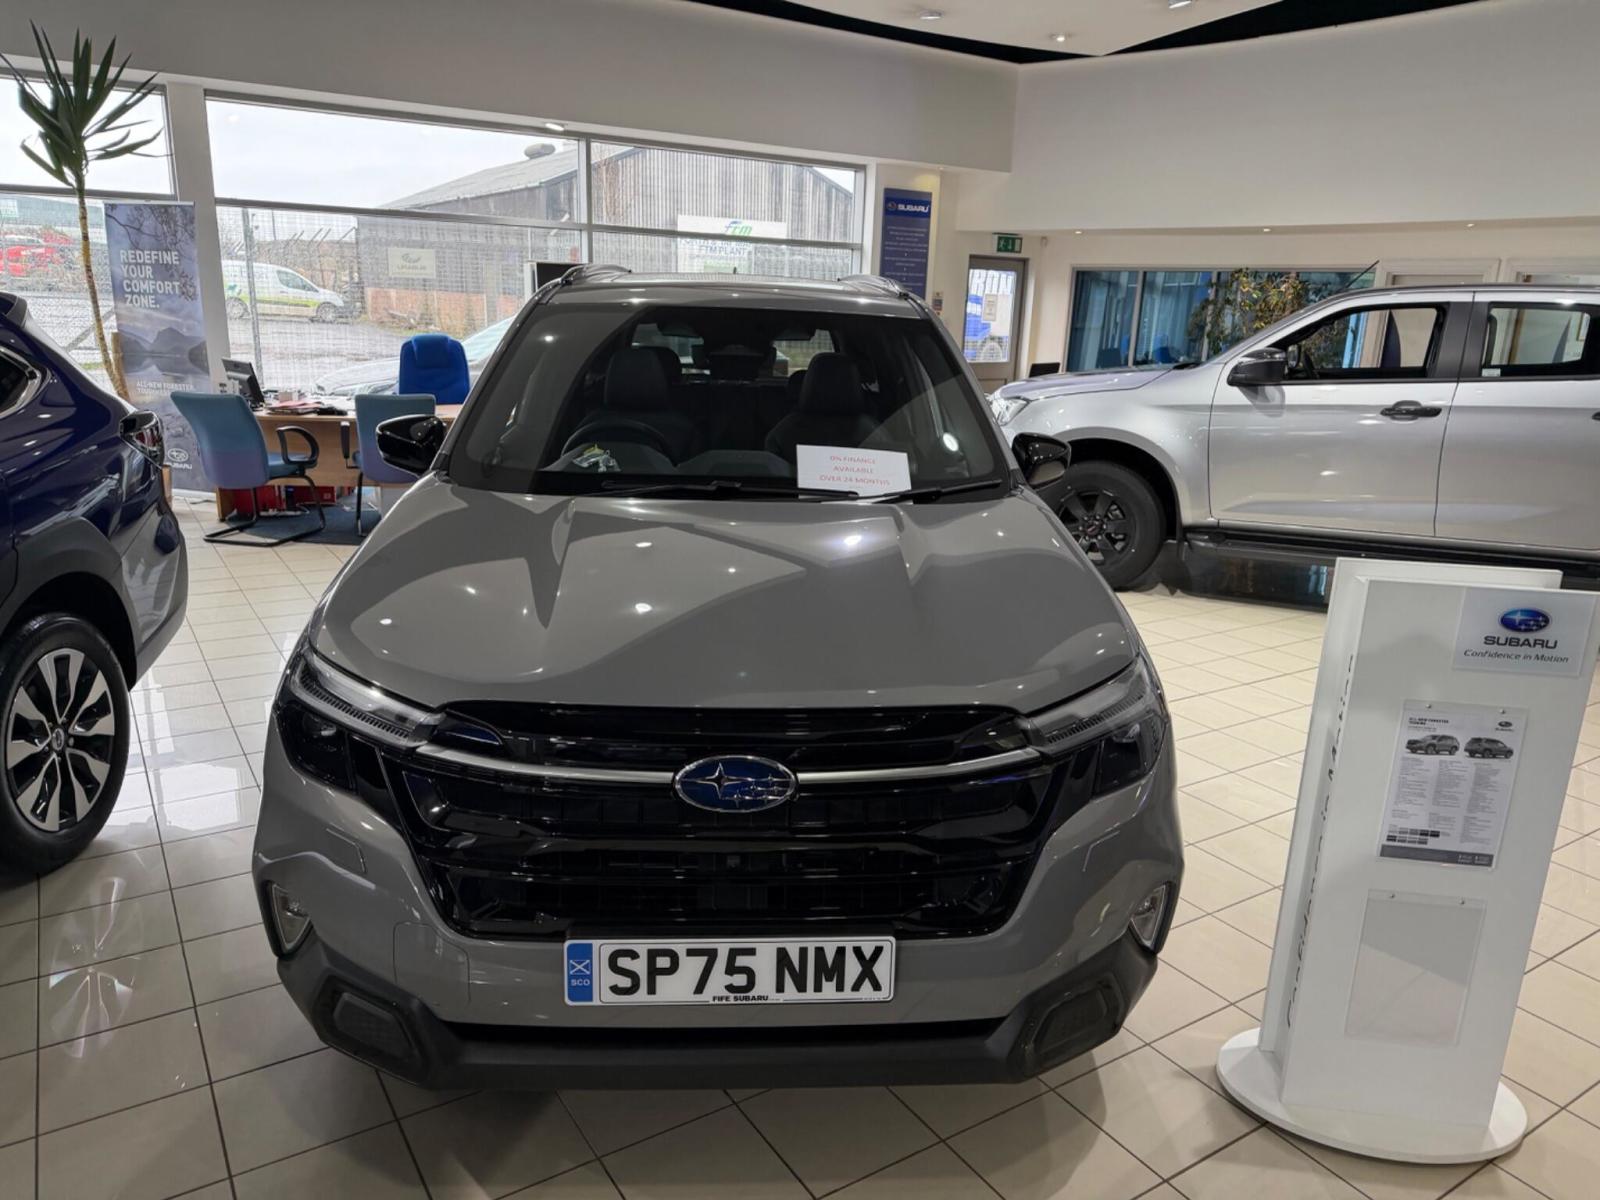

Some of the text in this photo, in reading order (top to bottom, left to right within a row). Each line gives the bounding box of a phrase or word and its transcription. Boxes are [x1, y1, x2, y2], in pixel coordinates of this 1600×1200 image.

[897, 203, 929, 213] SUBARU
[120, 250, 180, 265] REDEFINE
[121, 264, 154, 279] YOUR
[123, 280, 181, 295] COMFORT
[125, 294, 160, 309] ZONE.
[843, 456, 876, 465] FINANCE
[833, 465, 873, 474] AVAILABLE
[819, 474, 841, 482] OVER
[855, 477, 891, 486] MONTHS
[1483, 635, 1558, 650] SUBARU
[1463, 648, 1522, 661] Confidence
[1533, 653, 1569, 664] Motion
[607, 944, 885, 997] SP75 NMX
[570, 978, 591, 987] SCO
